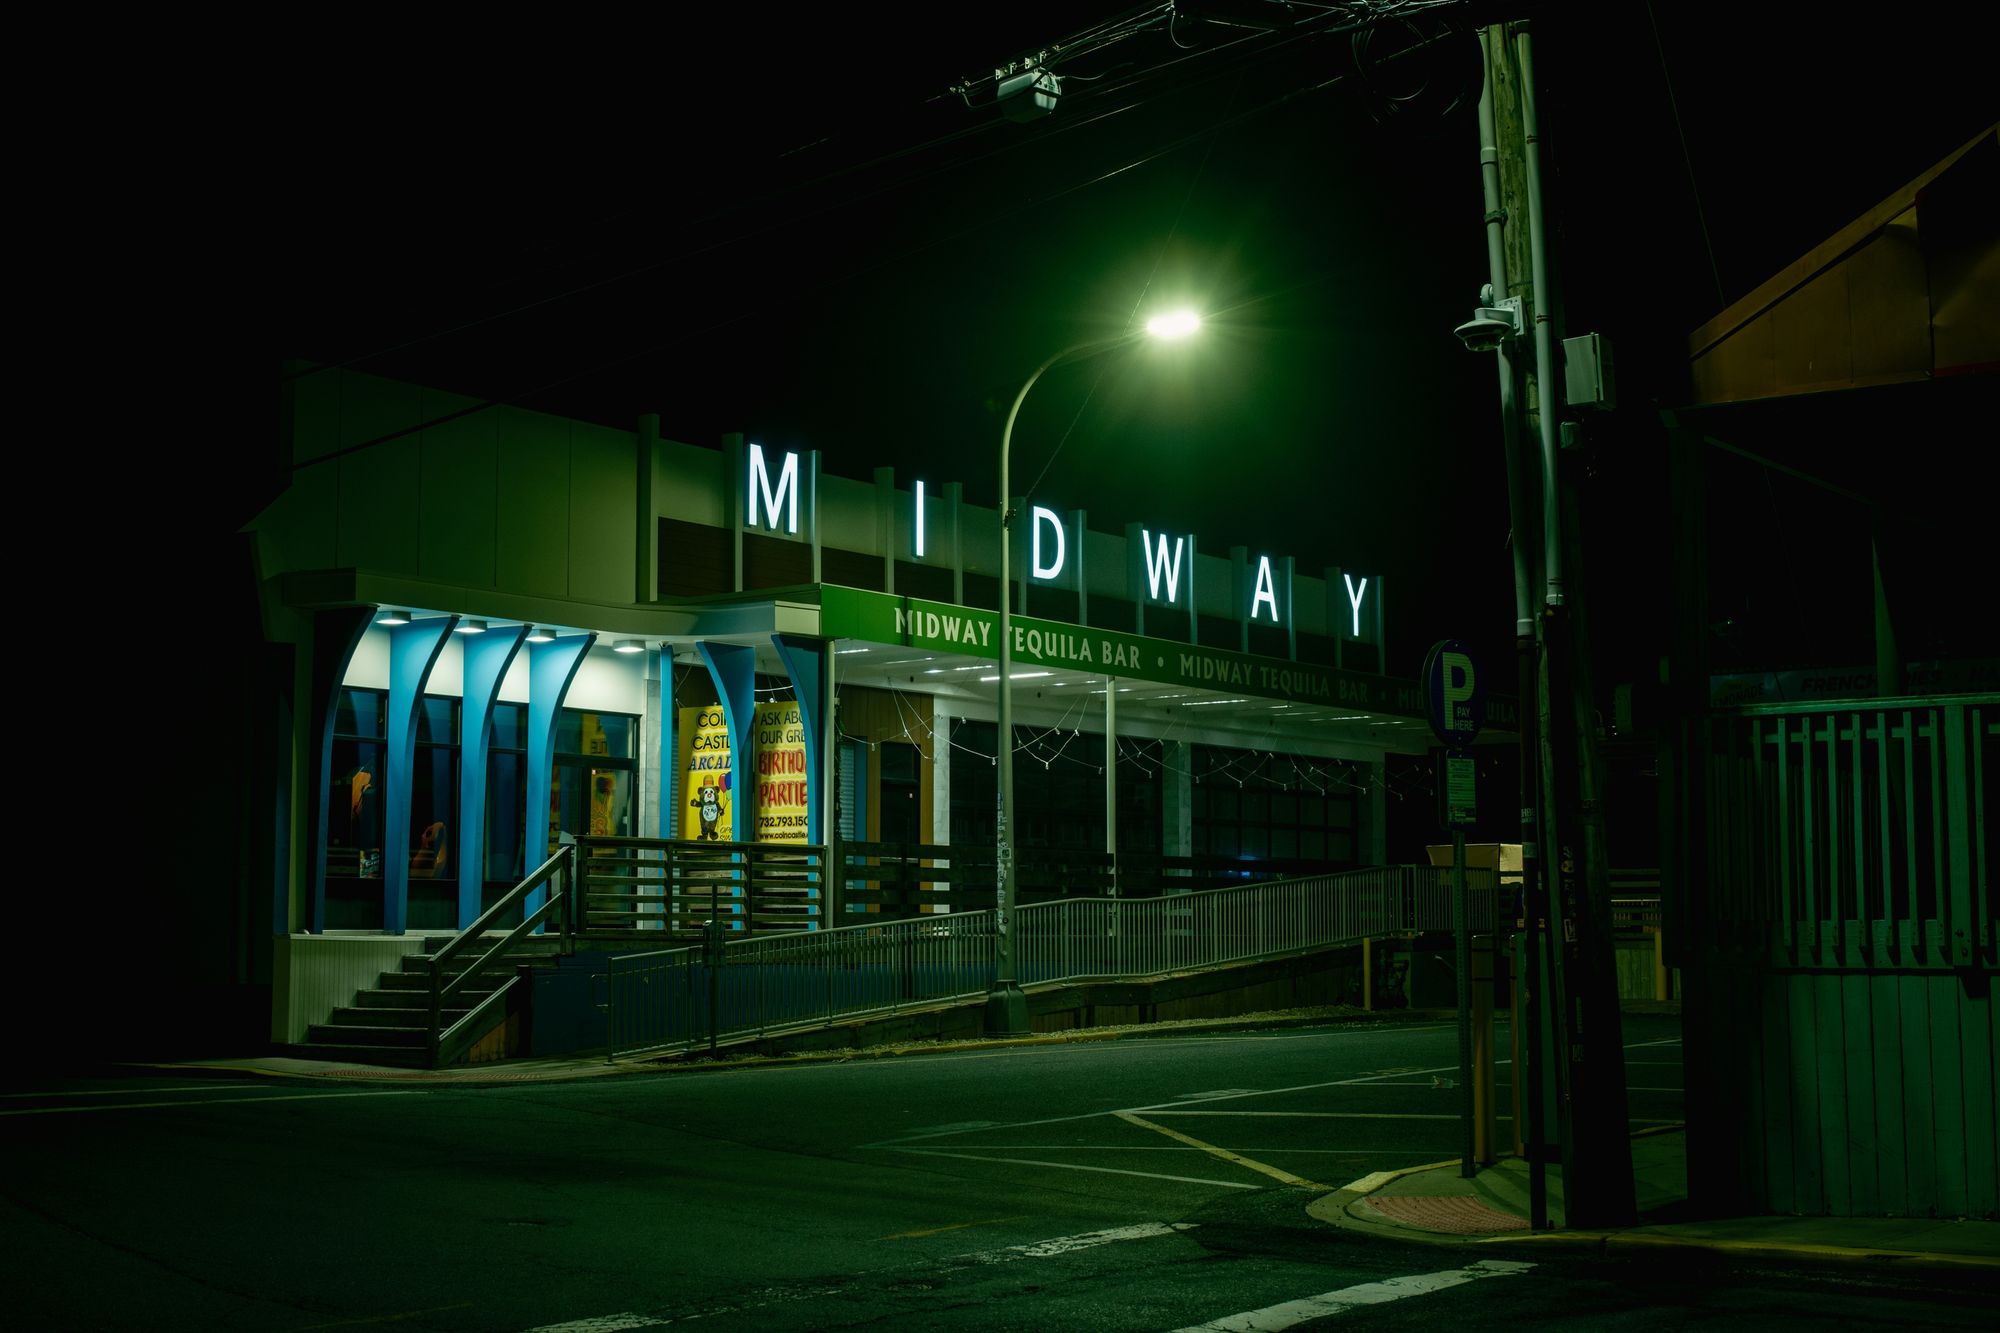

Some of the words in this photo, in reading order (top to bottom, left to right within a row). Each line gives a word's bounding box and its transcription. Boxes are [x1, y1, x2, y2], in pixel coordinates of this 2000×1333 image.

[747, 442, 1368, 638] MIDWAY
[894, 607, 992, 647] MIDWAY
[1008, 625, 1093, 662] EQUILA
[1101, 640, 1141, 670] BAR
[1179, 653, 1253, 687] MIDWAY
[1259, 668, 1332, 698] TEQUILA
[1338, 677, 1369, 703] BAR
[1441, 651, 1476, 731] P
[698, 712, 727, 728] COI
[760, 711, 781, 726] ASK
[1456, 706, 1471, 718] PAY
[1453, 720, 1474, 731] HERE
[760, 730, 783, 744] OUR
[758, 750, 807, 775] BIRTHD
